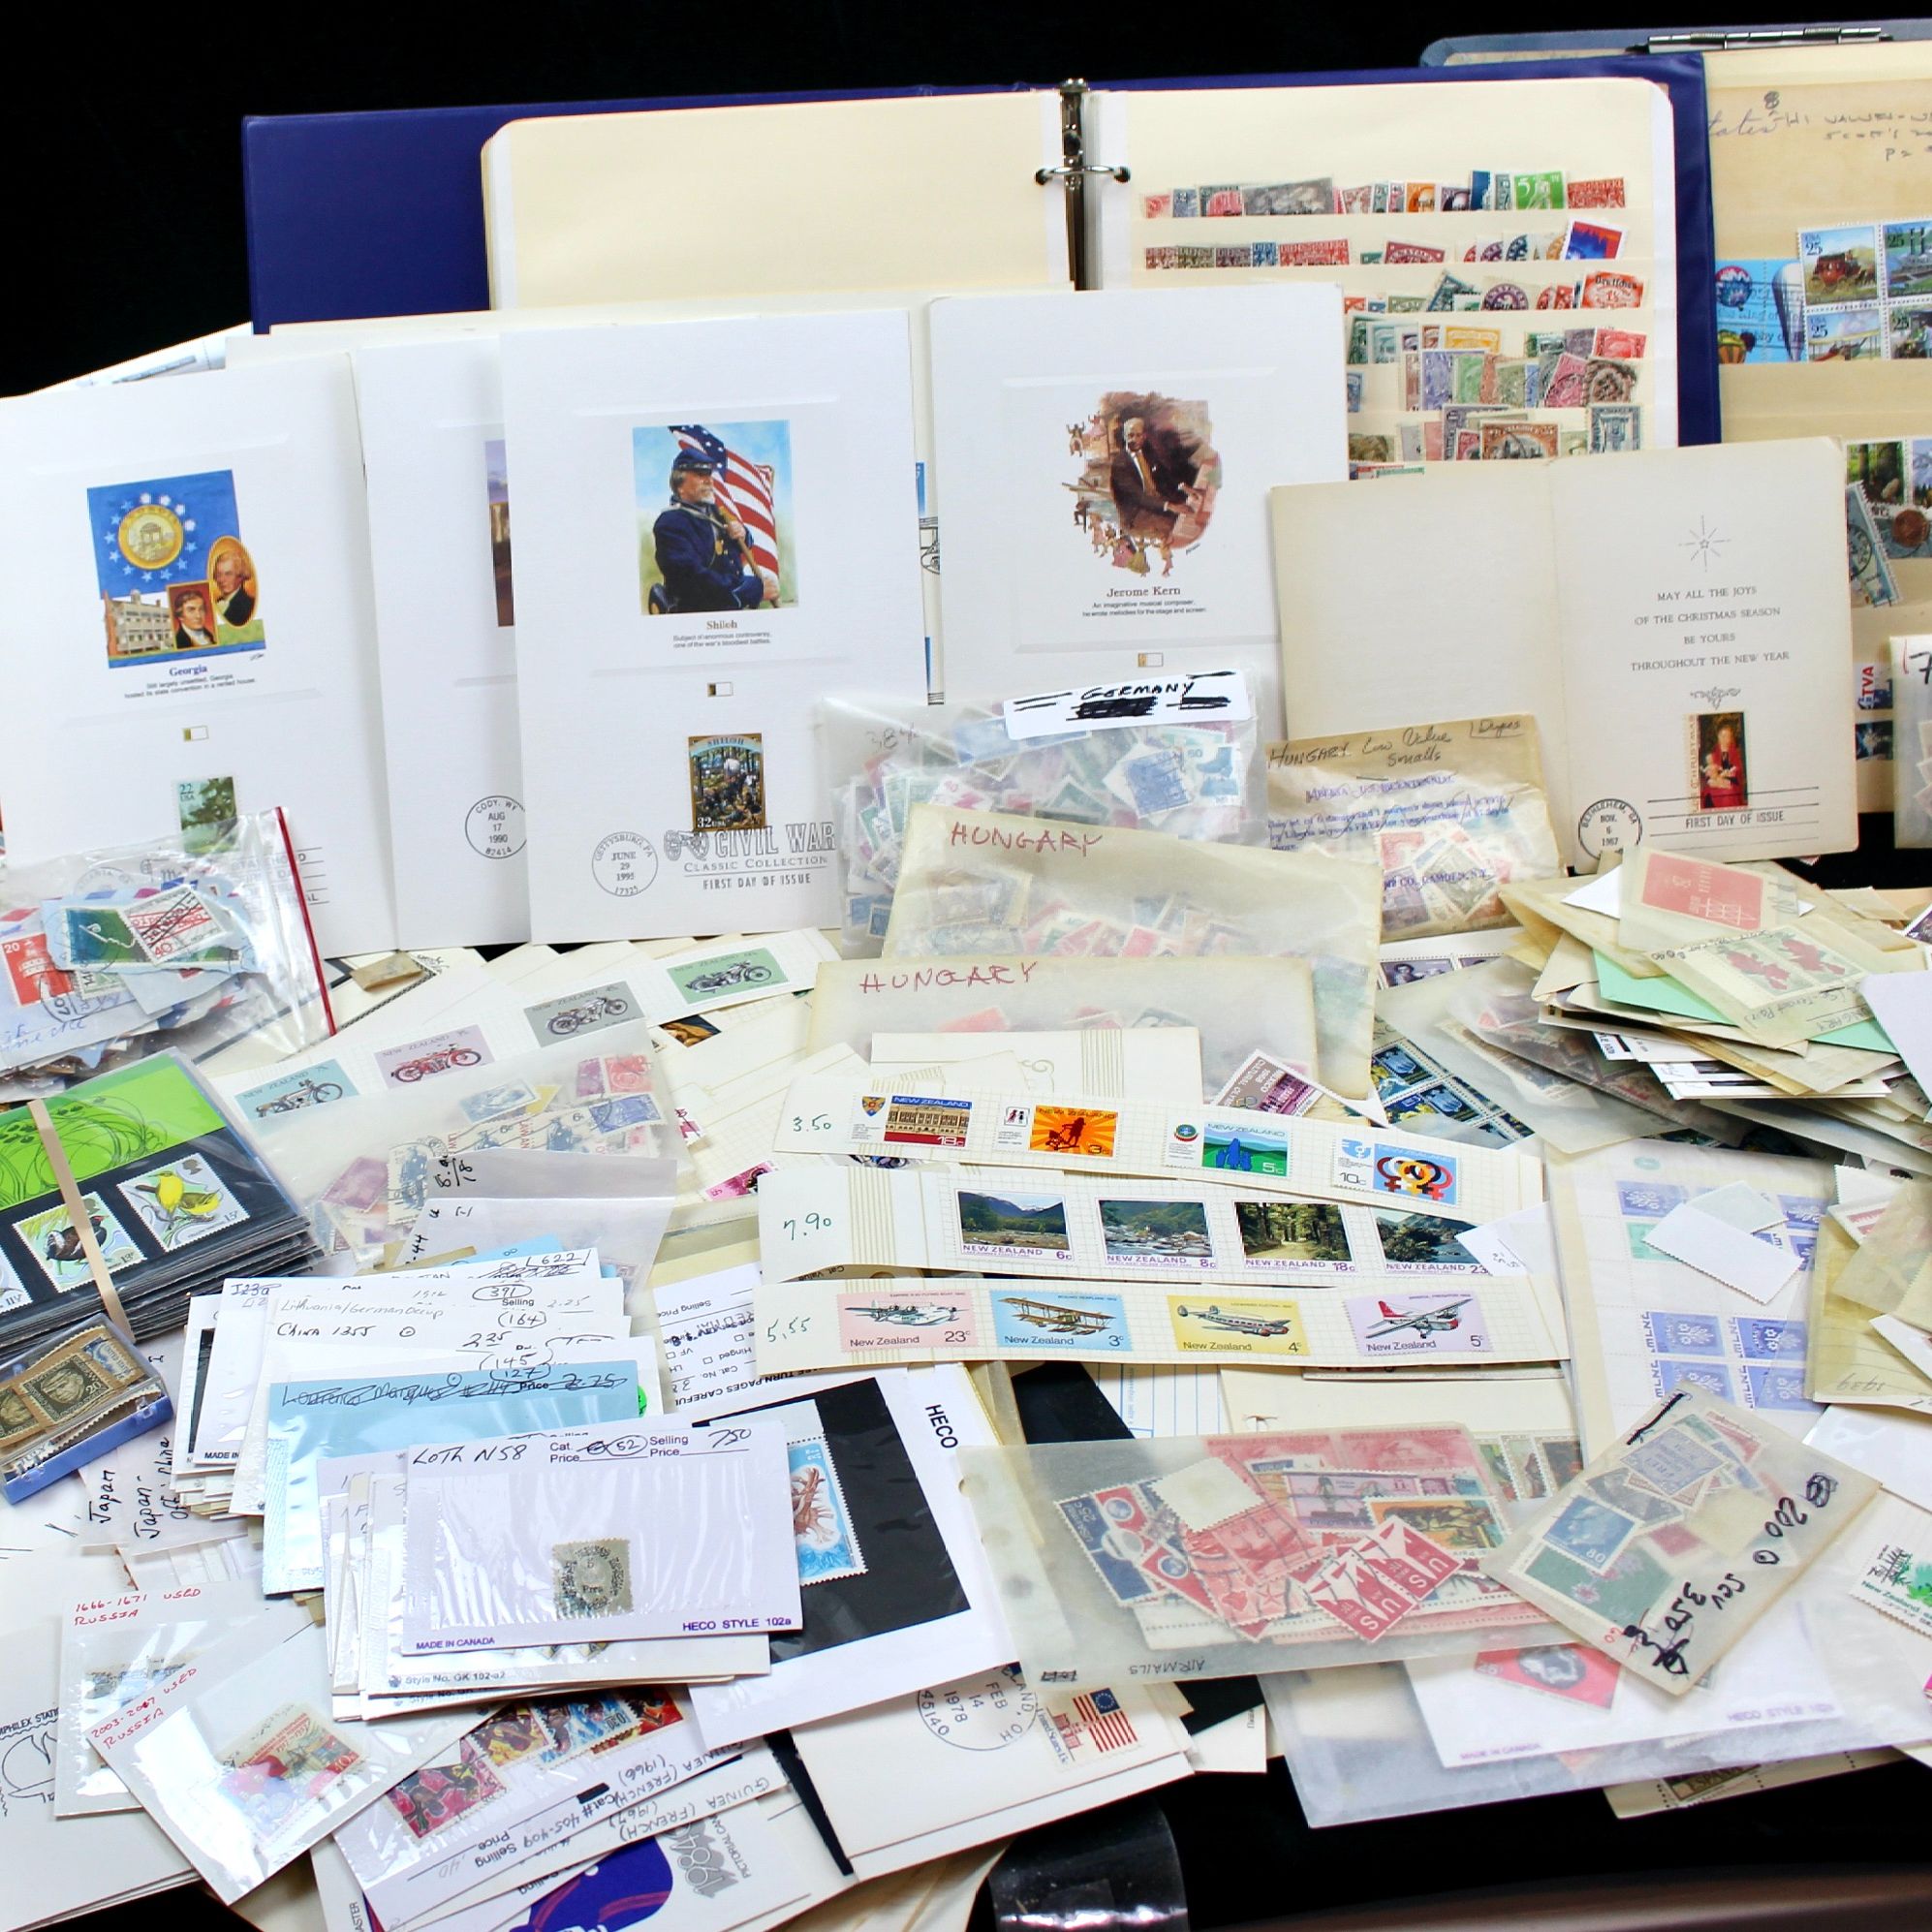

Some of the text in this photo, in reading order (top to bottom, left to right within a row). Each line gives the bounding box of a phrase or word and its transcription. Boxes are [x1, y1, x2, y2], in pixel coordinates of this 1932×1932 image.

[1805, 241, 1823, 256] 25
[1106, 585, 1181, 598] Jerome Kern
[1657, 585, 1758, 602] MAY ALL THE JOYS
[1635, 607, 1781, 626] OF THE CHRISTMAS SEASON
[706, 619, 738, 631] Shiloh
[1684, 633, 1735, 644] BE YOURS
[1631, 650, 1790, 671] THROUGHOUT THE NEW YEAR
[169, 664, 207, 677] Georgia
[179, 783, 194, 793] 22
[488, 812, 505, 821] AUG
[698, 817, 712, 828] 32
[1686, 810, 1784, 829] FIRST DAY OF ISSUE
[489, 834, 508, 843] 1990
[715, 822, 836, 857] CIVIL WAR
[950, 822, 1104, 857] HUNGARY
[611, 851, 636, 861] JUNE
[620, 861, 630, 871] 29
[703, 874, 810, 889] FIRST DAY OF ISSUE
[860, 961, 1038, 994] HUNGARY
[920, 1098, 969, 1108] ZEALAND
[1038, 1107, 1065, 1116] NEW
[793, 1113, 831, 1133] 3.50
[1208, 1123, 1286, 1137] NEW ZEALAND
[992, 1246, 1044, 1256] ZEALAND
[1056, 1250, 1073, 1261] 6c
[1106, 1255, 1217, 1268] NEW ZEALAND 8c
[1275, 1260, 1326, 1269] ZEALAND
[1415, 1262, 1466, 1271] ZEALAND
[502, 1297, 534, 1308] Selling
[680, 1300, 711, 1311] Selling
[850, 1335, 919, 1348] New Zealand
[1005, 1335, 1074, 1347] New Zealand
[1183, 1340, 1253, 1351] New Zealand
[1366, 1339, 1437, 1352] New Zealand
[719, 1346, 752, 1360] Hinged
[720, 1364, 738, 1374] Cat.
[519, 1381, 549, 1391] Price
[727, 1379, 763, 1392] PAGES
[926, 1404, 957, 1449] HECO
[549, 1441, 573, 1452] Cat.
[649, 1434, 689, 1449] Selling
[550, 1453, 579, 1464] Price
[649, 1448, 679, 1458] Price
[74, 1608, 140, 1626] RUSSIA
[683, 1616, 792, 1632] HECO STYLE 102a
[416, 1636, 495, 1650] MADE IN CANADA
[969, 1694, 984, 1708] 14
[986, 1682, 1008, 1709] FEB
[921, 1690, 950, 1736] 45140
[944, 1691, 968, 1723] 1978
[103, 1708, 166, 1750] RUSSIA
[707, 1777, 769, 1809] GUINEA
[478, 1830, 511, 1851] Price
[475, 1842, 517, 1868] Selling
